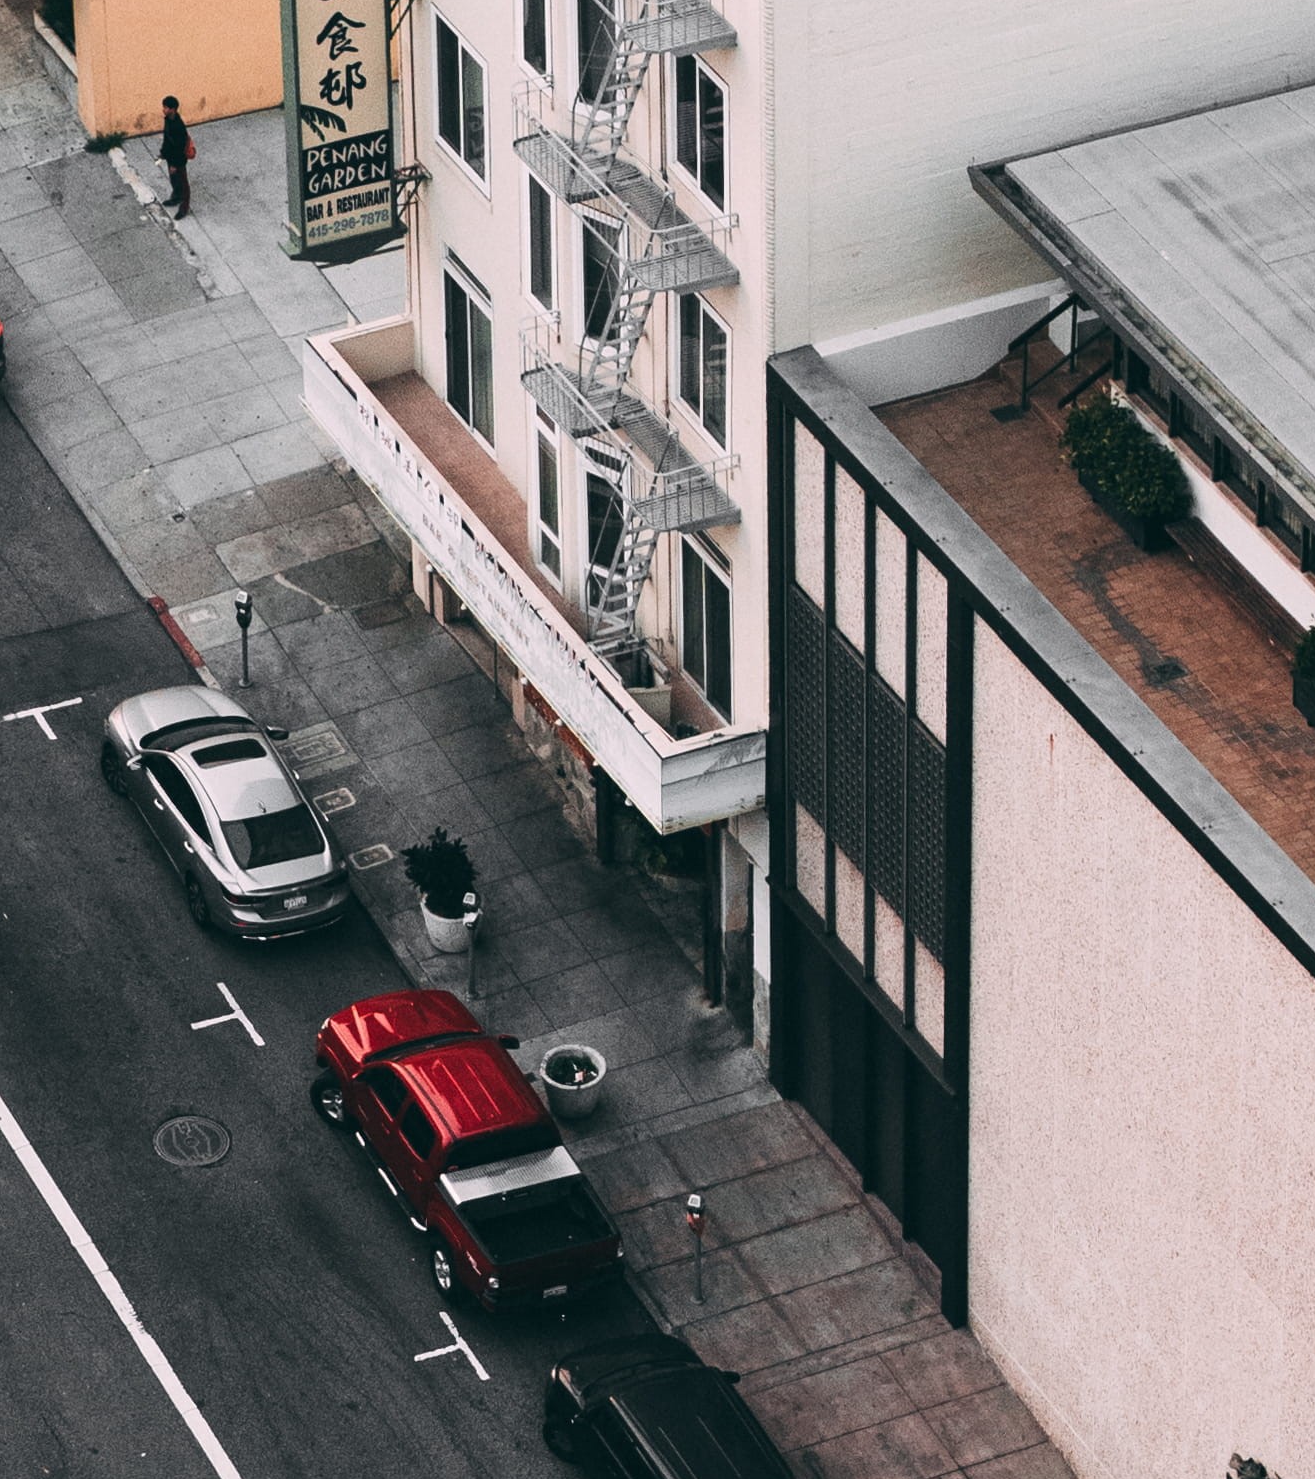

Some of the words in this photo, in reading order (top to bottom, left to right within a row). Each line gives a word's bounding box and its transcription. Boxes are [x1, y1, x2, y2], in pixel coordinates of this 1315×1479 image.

[307, 134, 387, 172] PENANG
[308, 160, 387, 194] GARDEN
[307, 203, 324, 222] BAR
[327, 200, 333, 217] &
[337, 187, 390, 214] RESTAURANT
